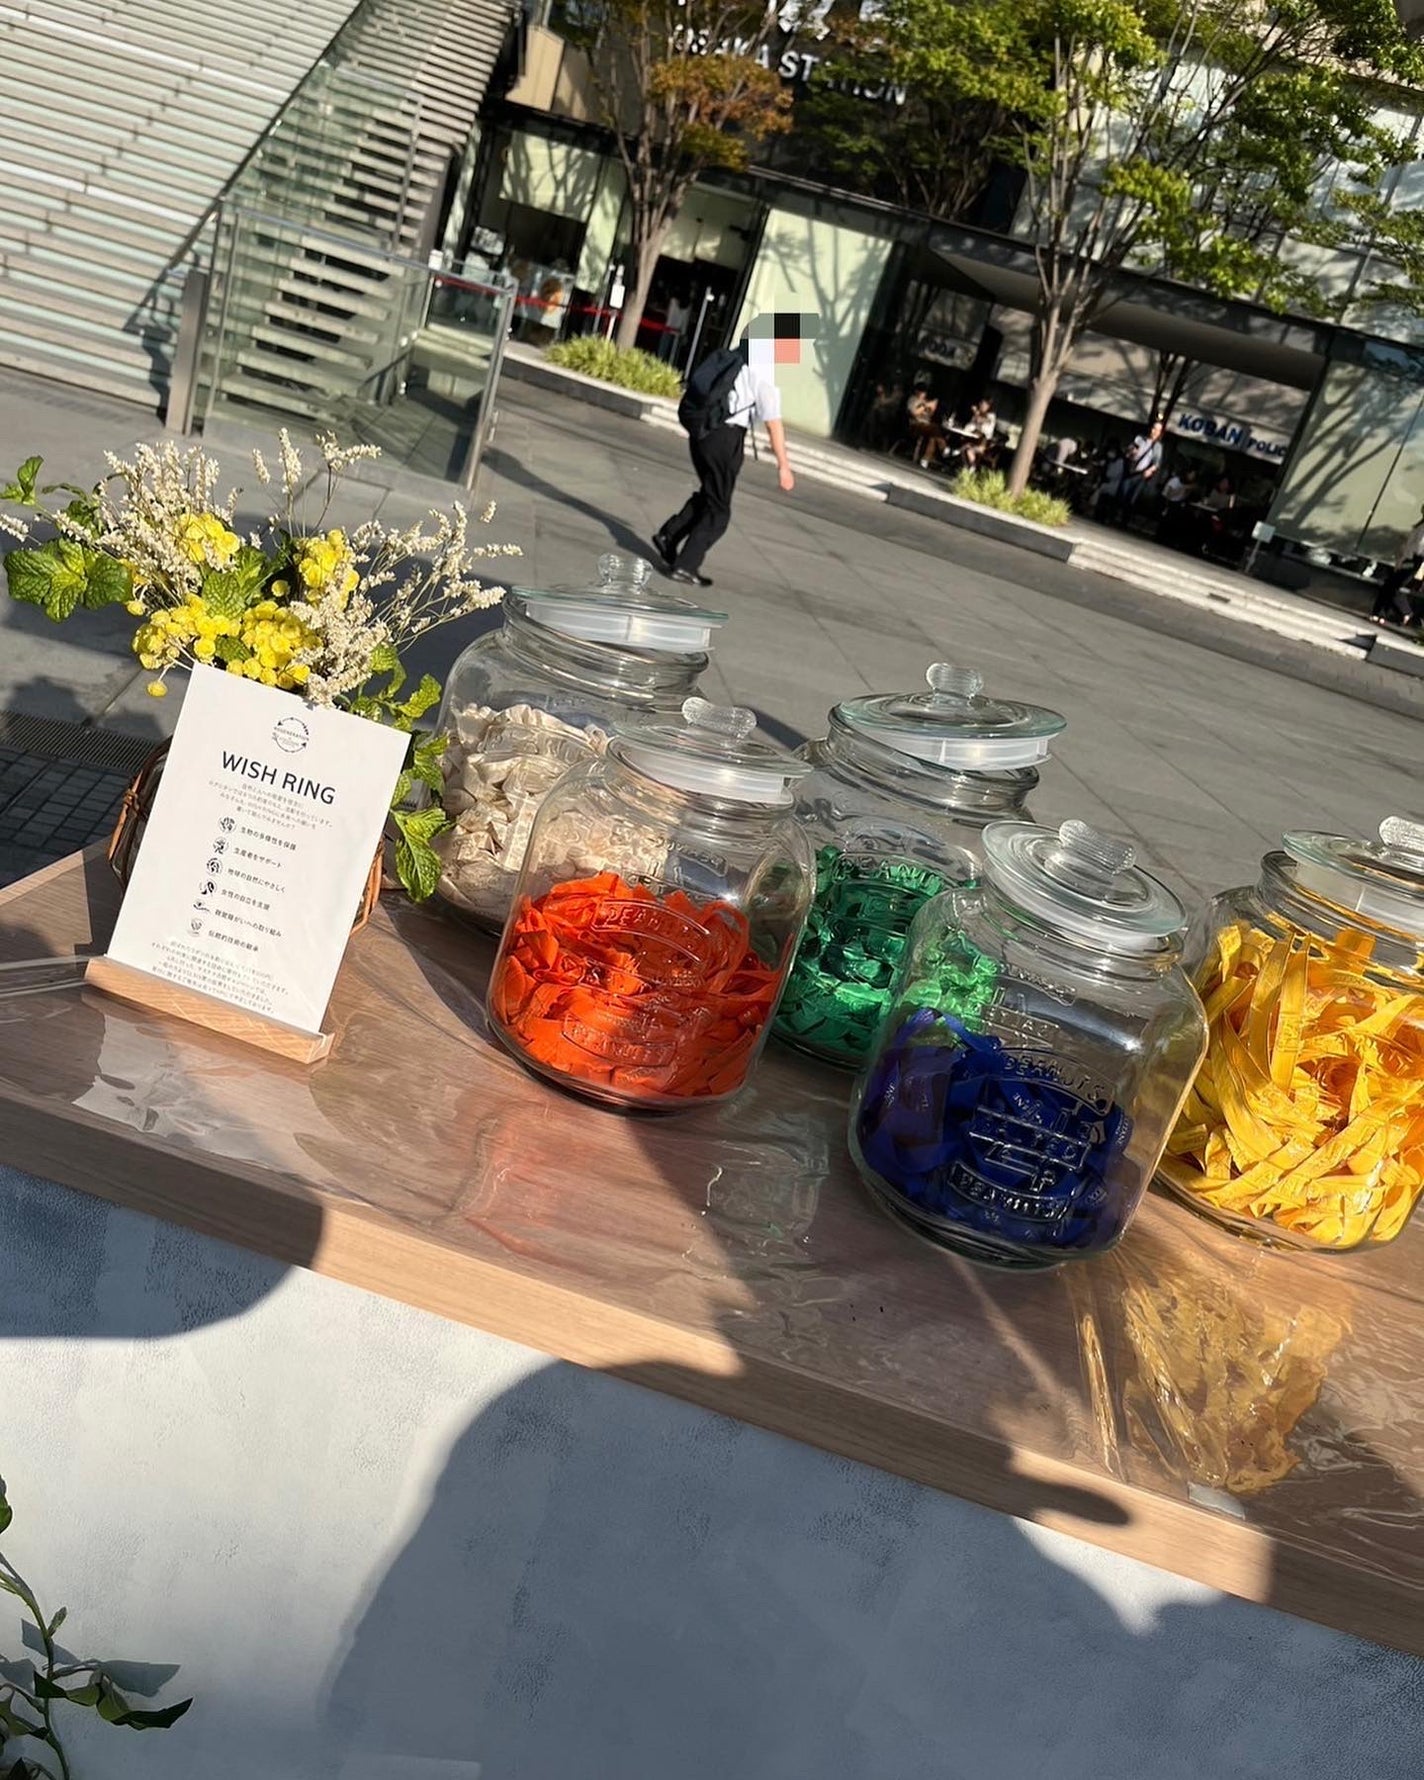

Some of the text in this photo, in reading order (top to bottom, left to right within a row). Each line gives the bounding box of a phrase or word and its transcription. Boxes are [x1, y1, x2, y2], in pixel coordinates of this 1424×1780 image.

[1178, 413, 1243, 444] KOBAN
[222, 751, 277, 785] WISH
[282, 772, 336, 805] RING
